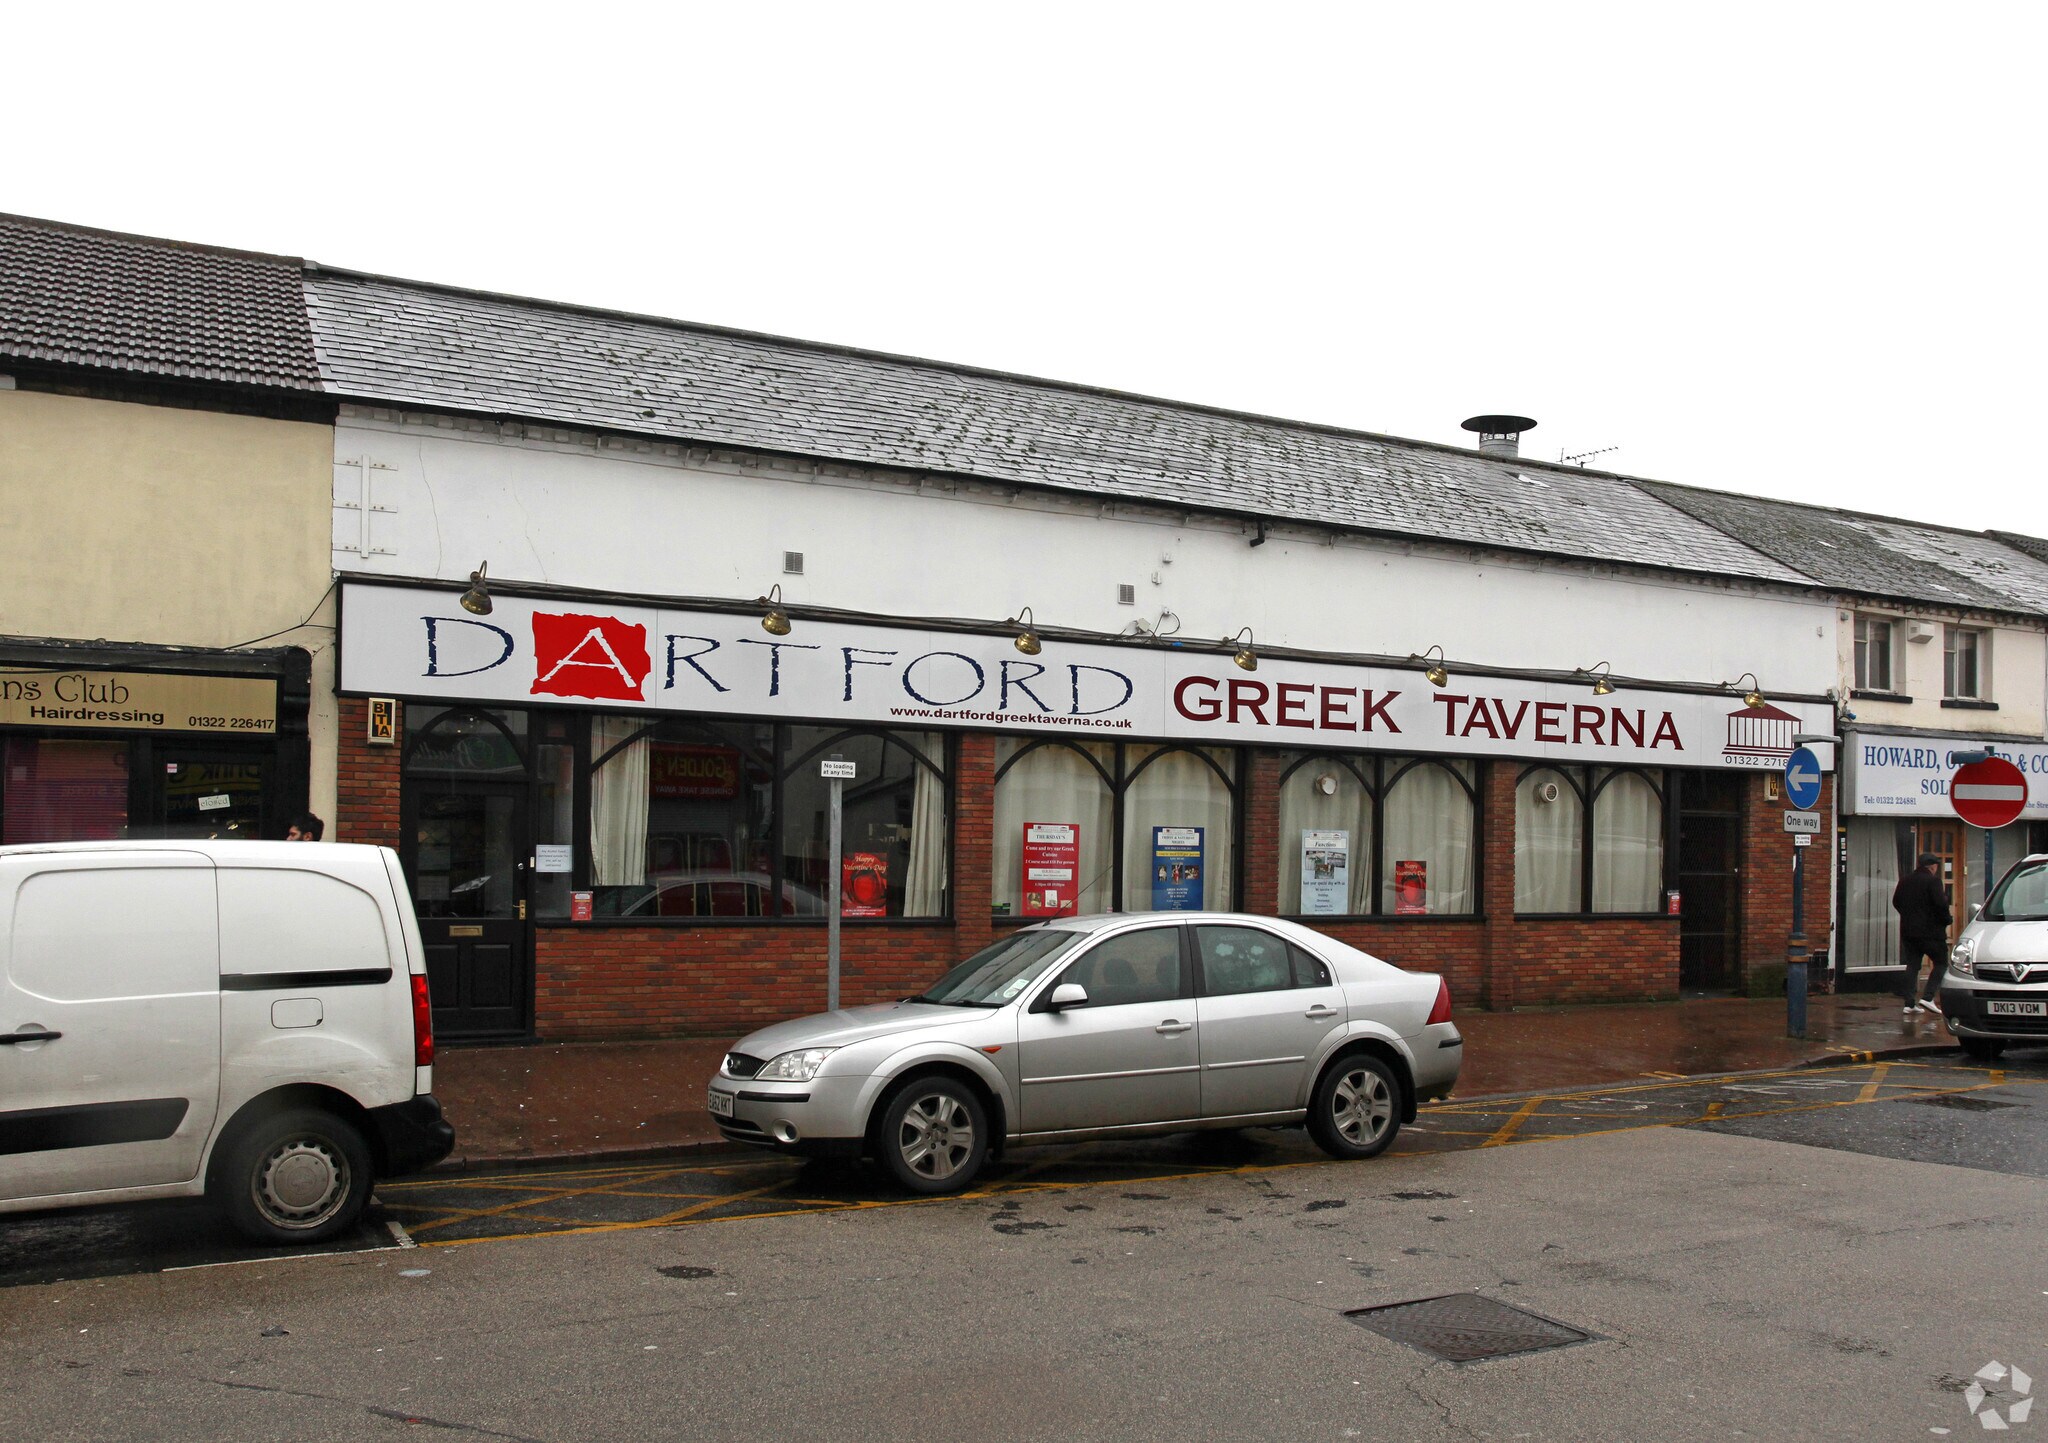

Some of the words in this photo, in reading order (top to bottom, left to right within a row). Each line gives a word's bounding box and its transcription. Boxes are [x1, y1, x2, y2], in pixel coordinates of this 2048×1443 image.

[0, 681, 41, 701] ns
[55, 675, 129, 704] Club
[420, 616, 1133, 715] DARTFORD
[1173, 676, 1402, 733] GREEK
[1433, 692, 1684, 750] TAVERNA
[30, 706, 164, 725] Hairdressing
[188, 716, 226, 728] 01322
[230, 718, 275, 729] 226417
[890, 706, 1132, 729] www.dartfordgreektaverna.co.uk
[1725, 755, 1759, 766] 01322
[1764, 757, 1788, 768] 2718
[1864, 746, 1940, 773] HOWARD,
[2017, 753, 2027, 772] &
[1921, 779, 1950, 795] SOL
[1786, 815, 1801, 826] One
[1803, 817, 1818, 828] way
[1993, 1003, 2016, 1013] DK13
